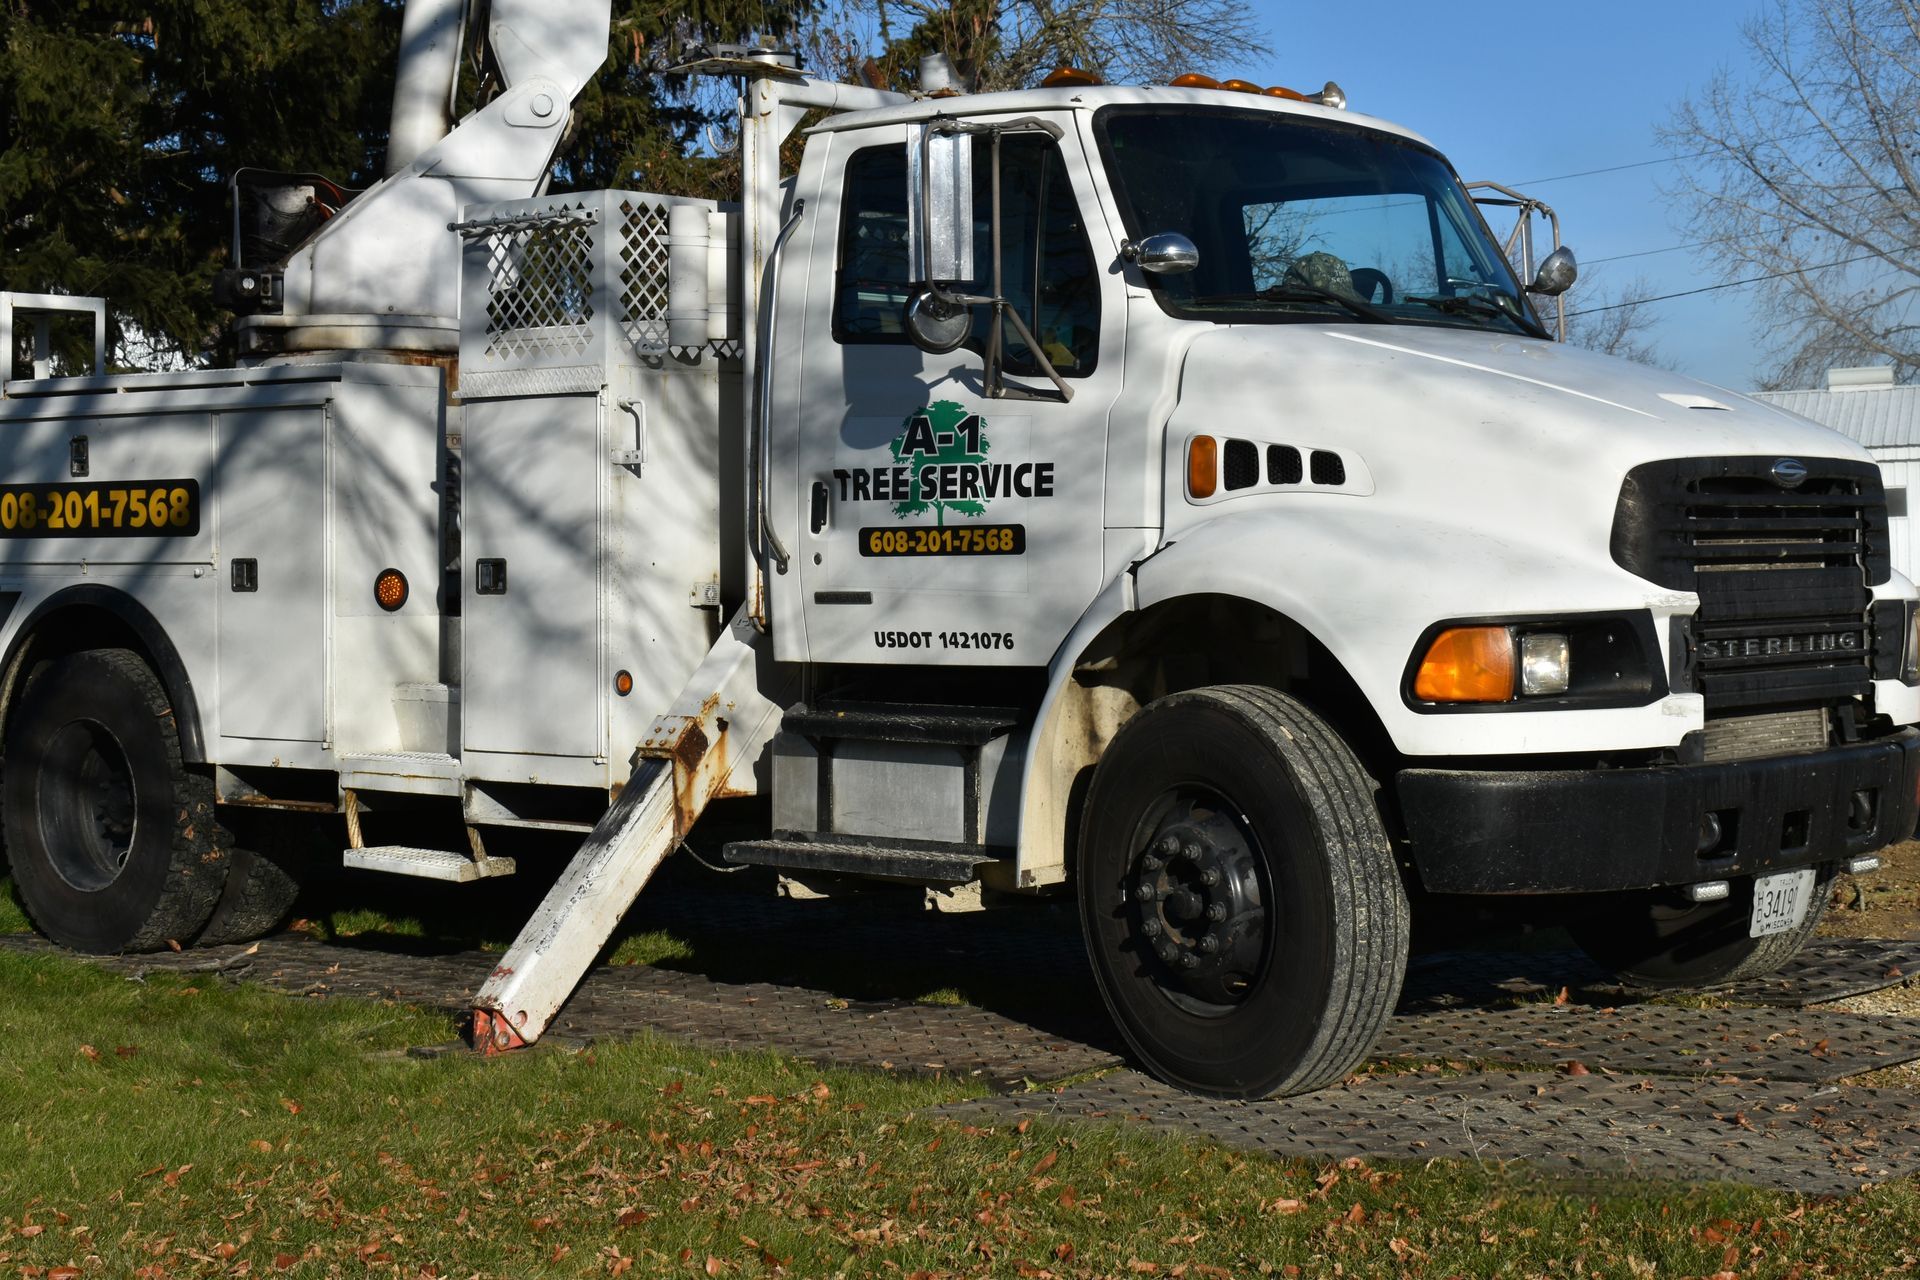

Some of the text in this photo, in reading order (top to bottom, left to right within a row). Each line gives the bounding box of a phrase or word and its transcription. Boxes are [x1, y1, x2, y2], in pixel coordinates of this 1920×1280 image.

[901, 415, 981, 456] A-1
[833, 462, 1055, 501] TREE SERVICE
[0, 488, 190, 529] 08-201-7568
[870, 528, 1014, 553] 608-201-7568
[874, 631, 1015, 650] USDOT 1421076
[1703, 632, 1857, 658] STERLING
